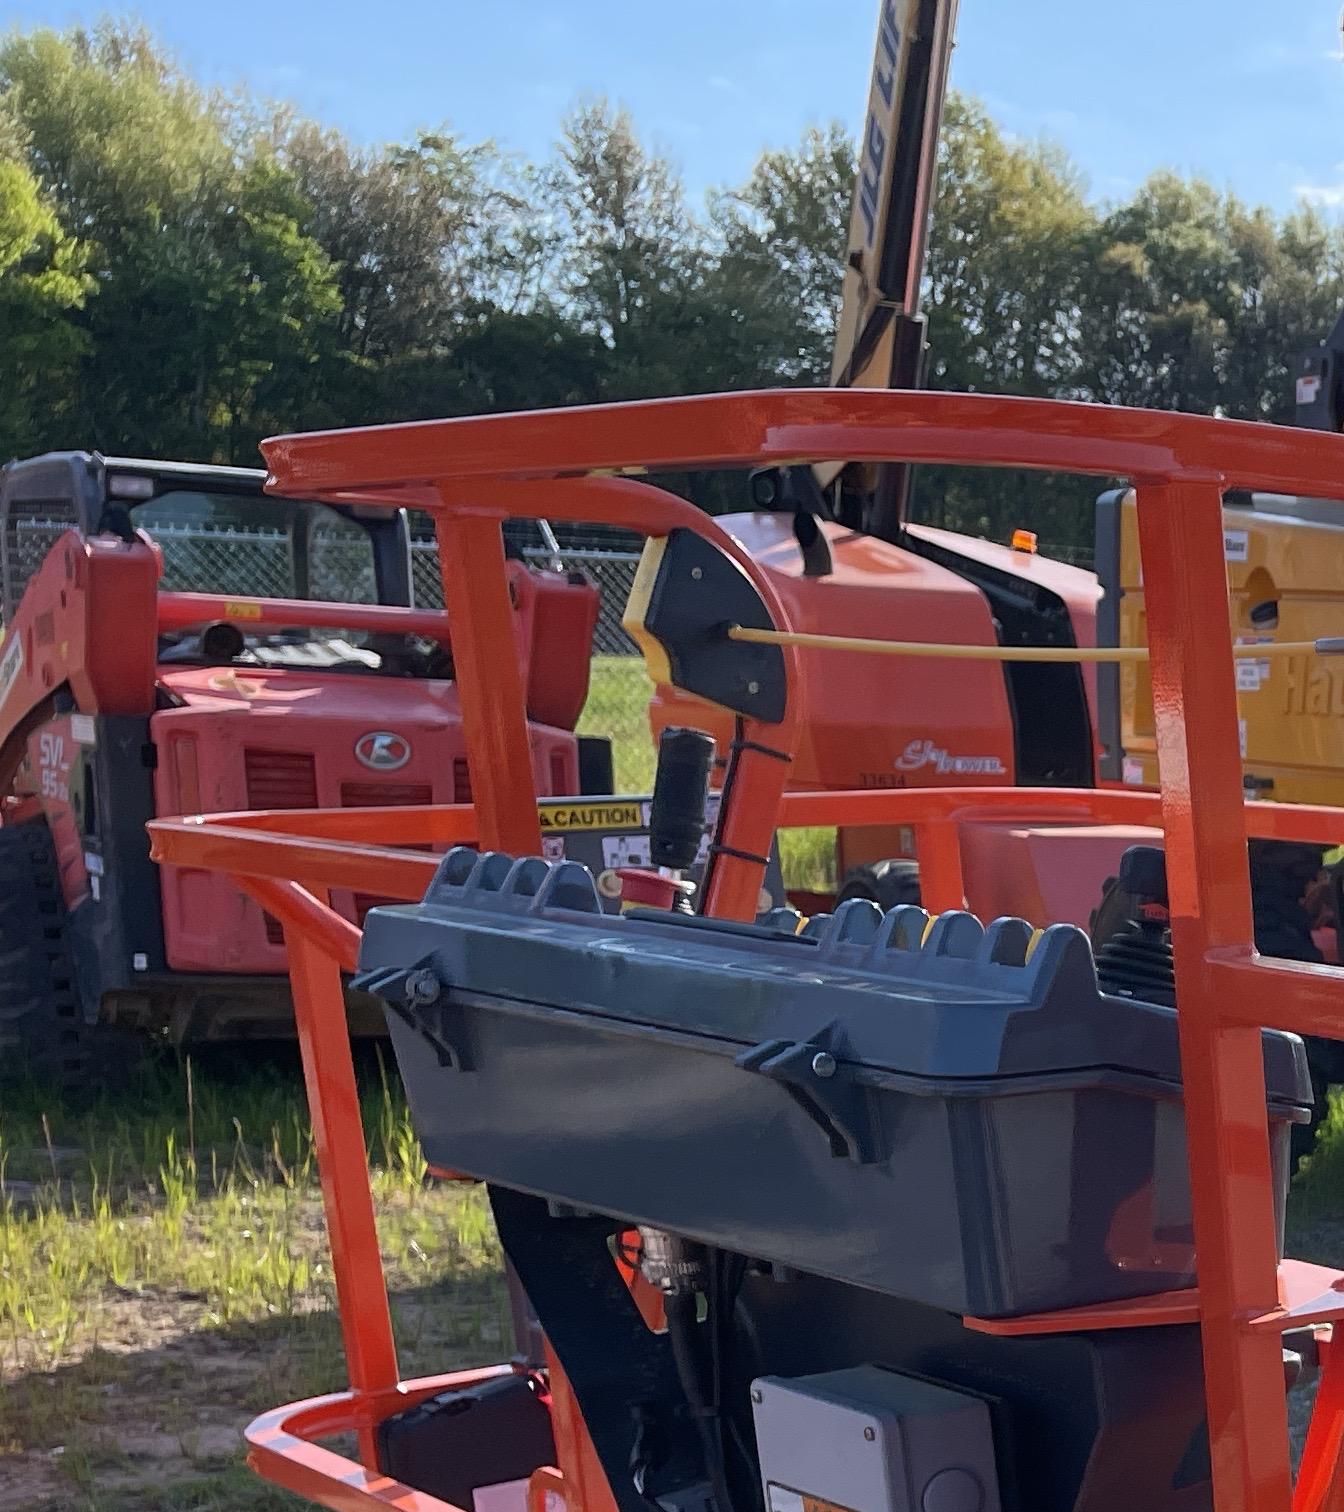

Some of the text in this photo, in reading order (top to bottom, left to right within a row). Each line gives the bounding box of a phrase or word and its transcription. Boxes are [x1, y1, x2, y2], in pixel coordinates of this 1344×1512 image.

[860, 0, 900, 247] JLG LIF
[554, 807, 638, 827] CAUTION
